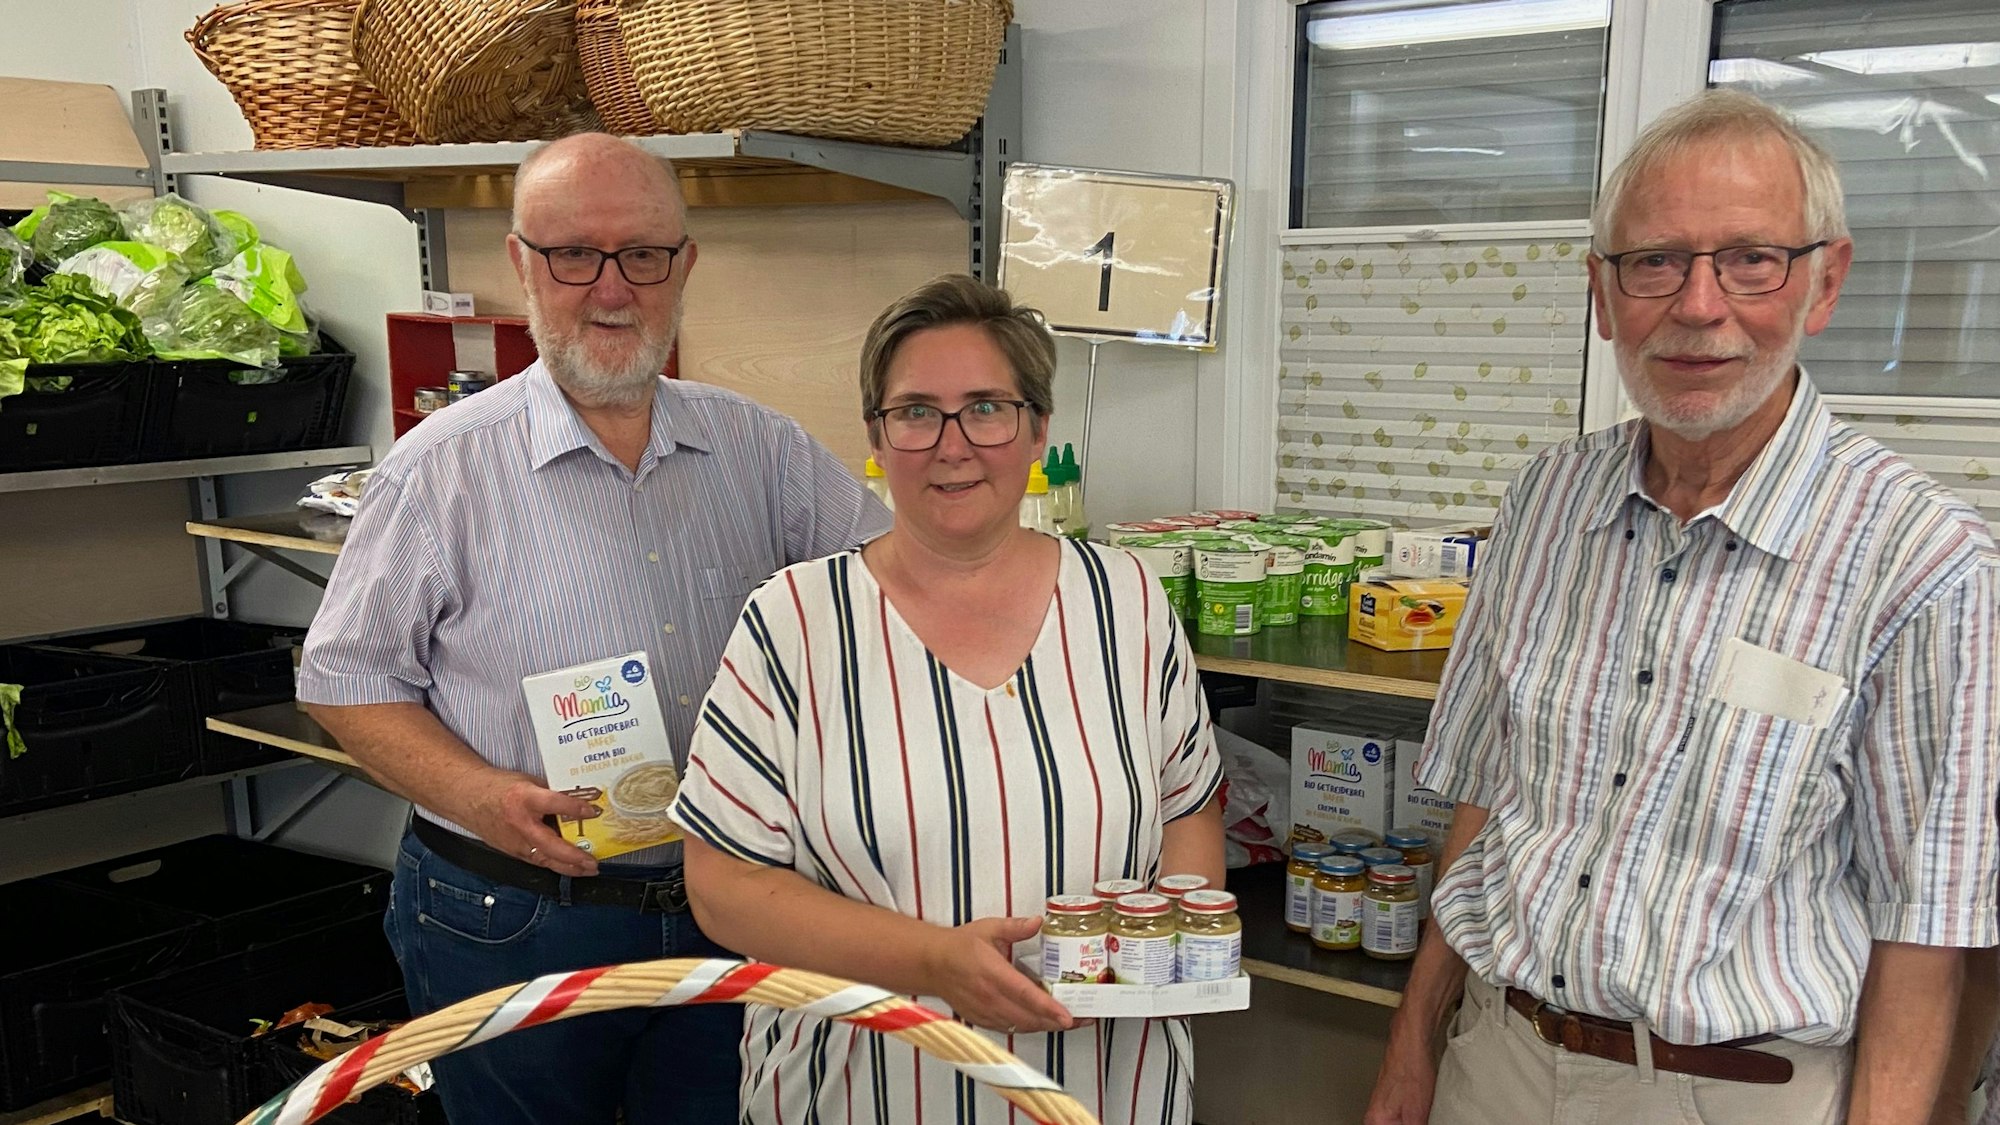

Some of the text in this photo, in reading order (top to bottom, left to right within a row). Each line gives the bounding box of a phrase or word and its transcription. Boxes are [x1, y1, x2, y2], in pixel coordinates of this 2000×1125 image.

[1083, 231, 1114, 311] 1
[574, 675, 592, 688] bio
[553, 692, 629, 720] Mamia
[558, 718, 639, 745] BIO GETREIDEBREI
[584, 747, 625, 763] CREMA BIO
[1308, 747, 1362, 778] Mamia
[1304, 780, 1365, 798] BIO GETREIDEBREI
[1318, 804, 1350, 816] CREMA BIO
